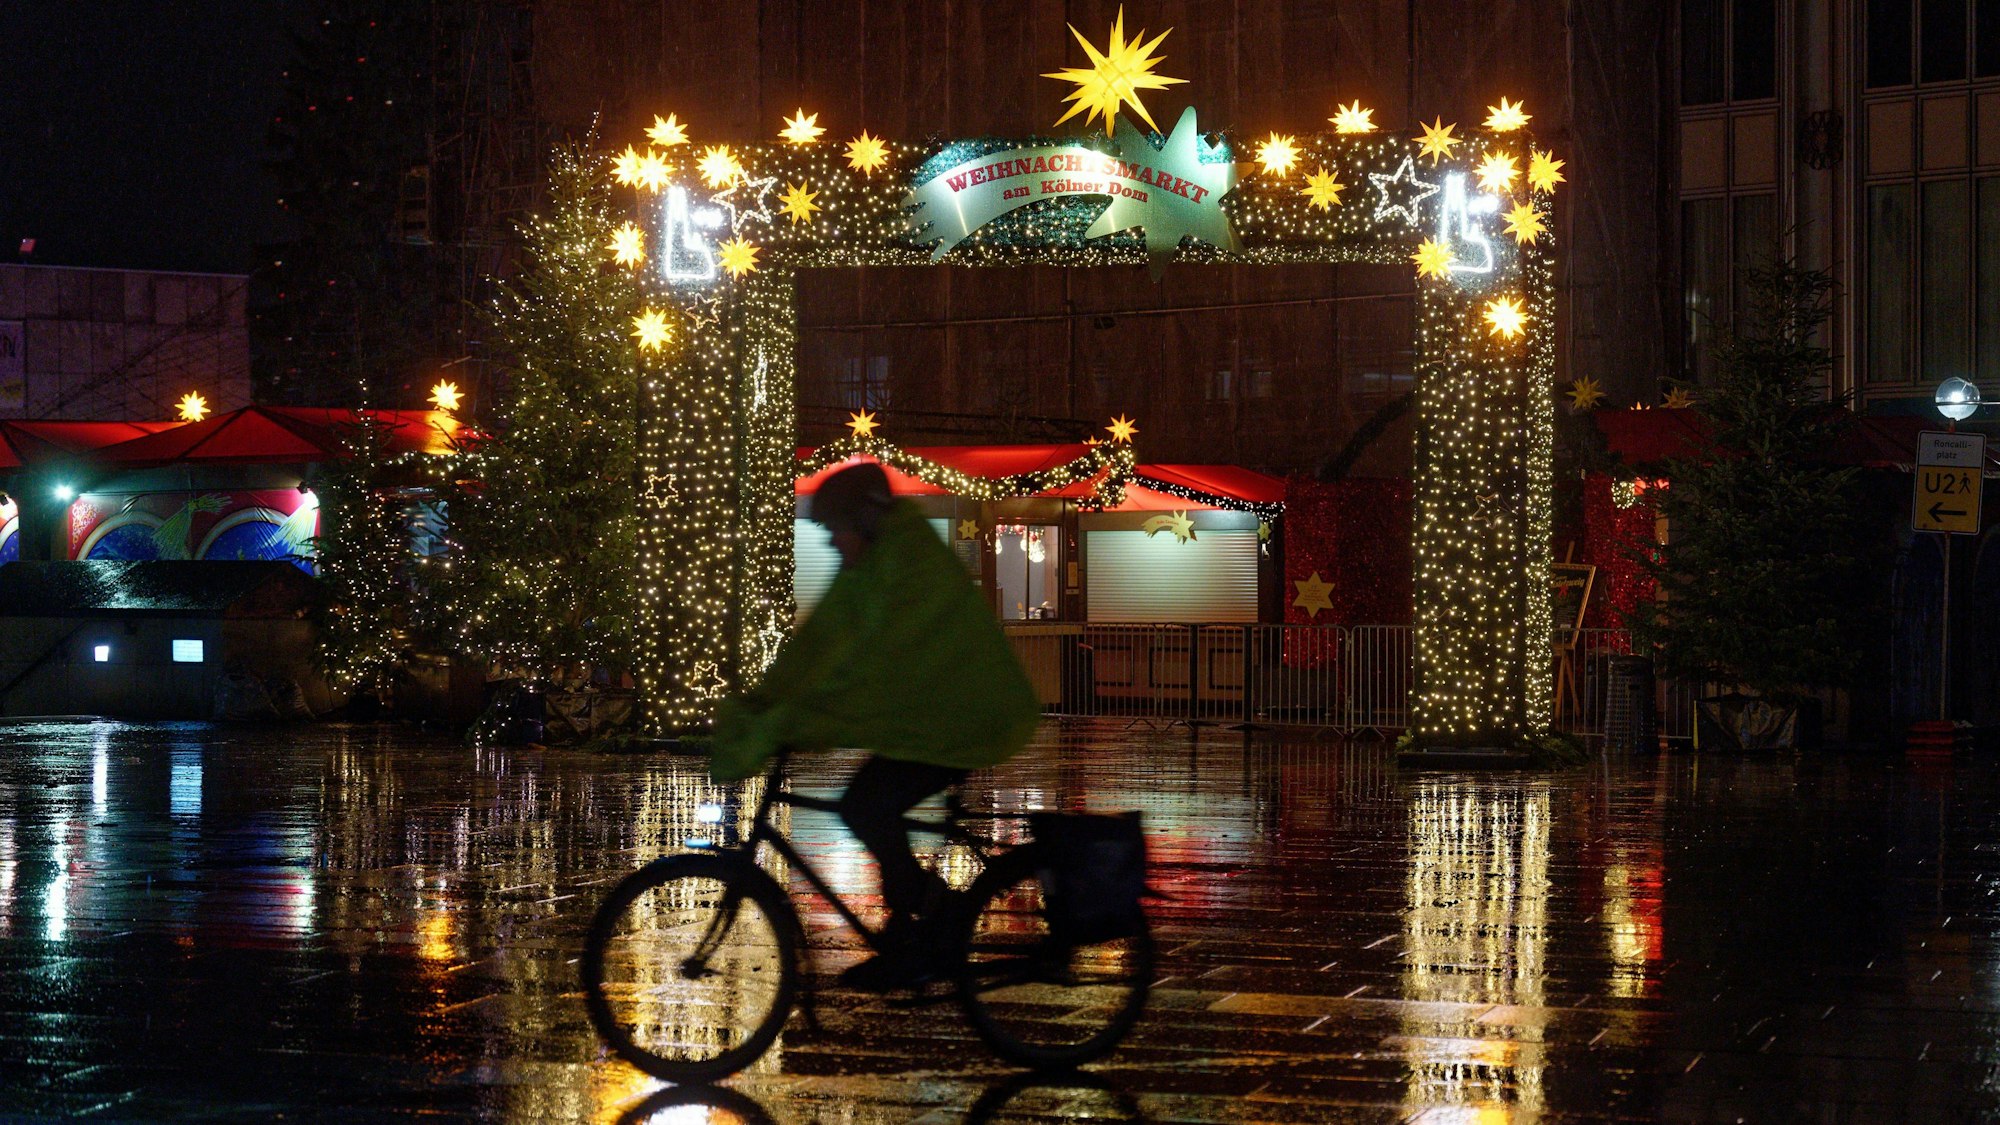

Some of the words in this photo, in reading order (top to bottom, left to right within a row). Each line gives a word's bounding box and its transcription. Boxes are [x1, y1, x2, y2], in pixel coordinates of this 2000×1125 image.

[945, 154, 1209, 205] WEIHNACHSMARKT
[1002, 185, 1031, 201] am
[1040, 178, 1103, 194] Kölner
[1107, 180, 1149, 203] Dom
[1934, 439, 1972, 449] Roncalli-
[1936, 449, 1957, 460] platz
[1925, 472, 1955, 494] U2
